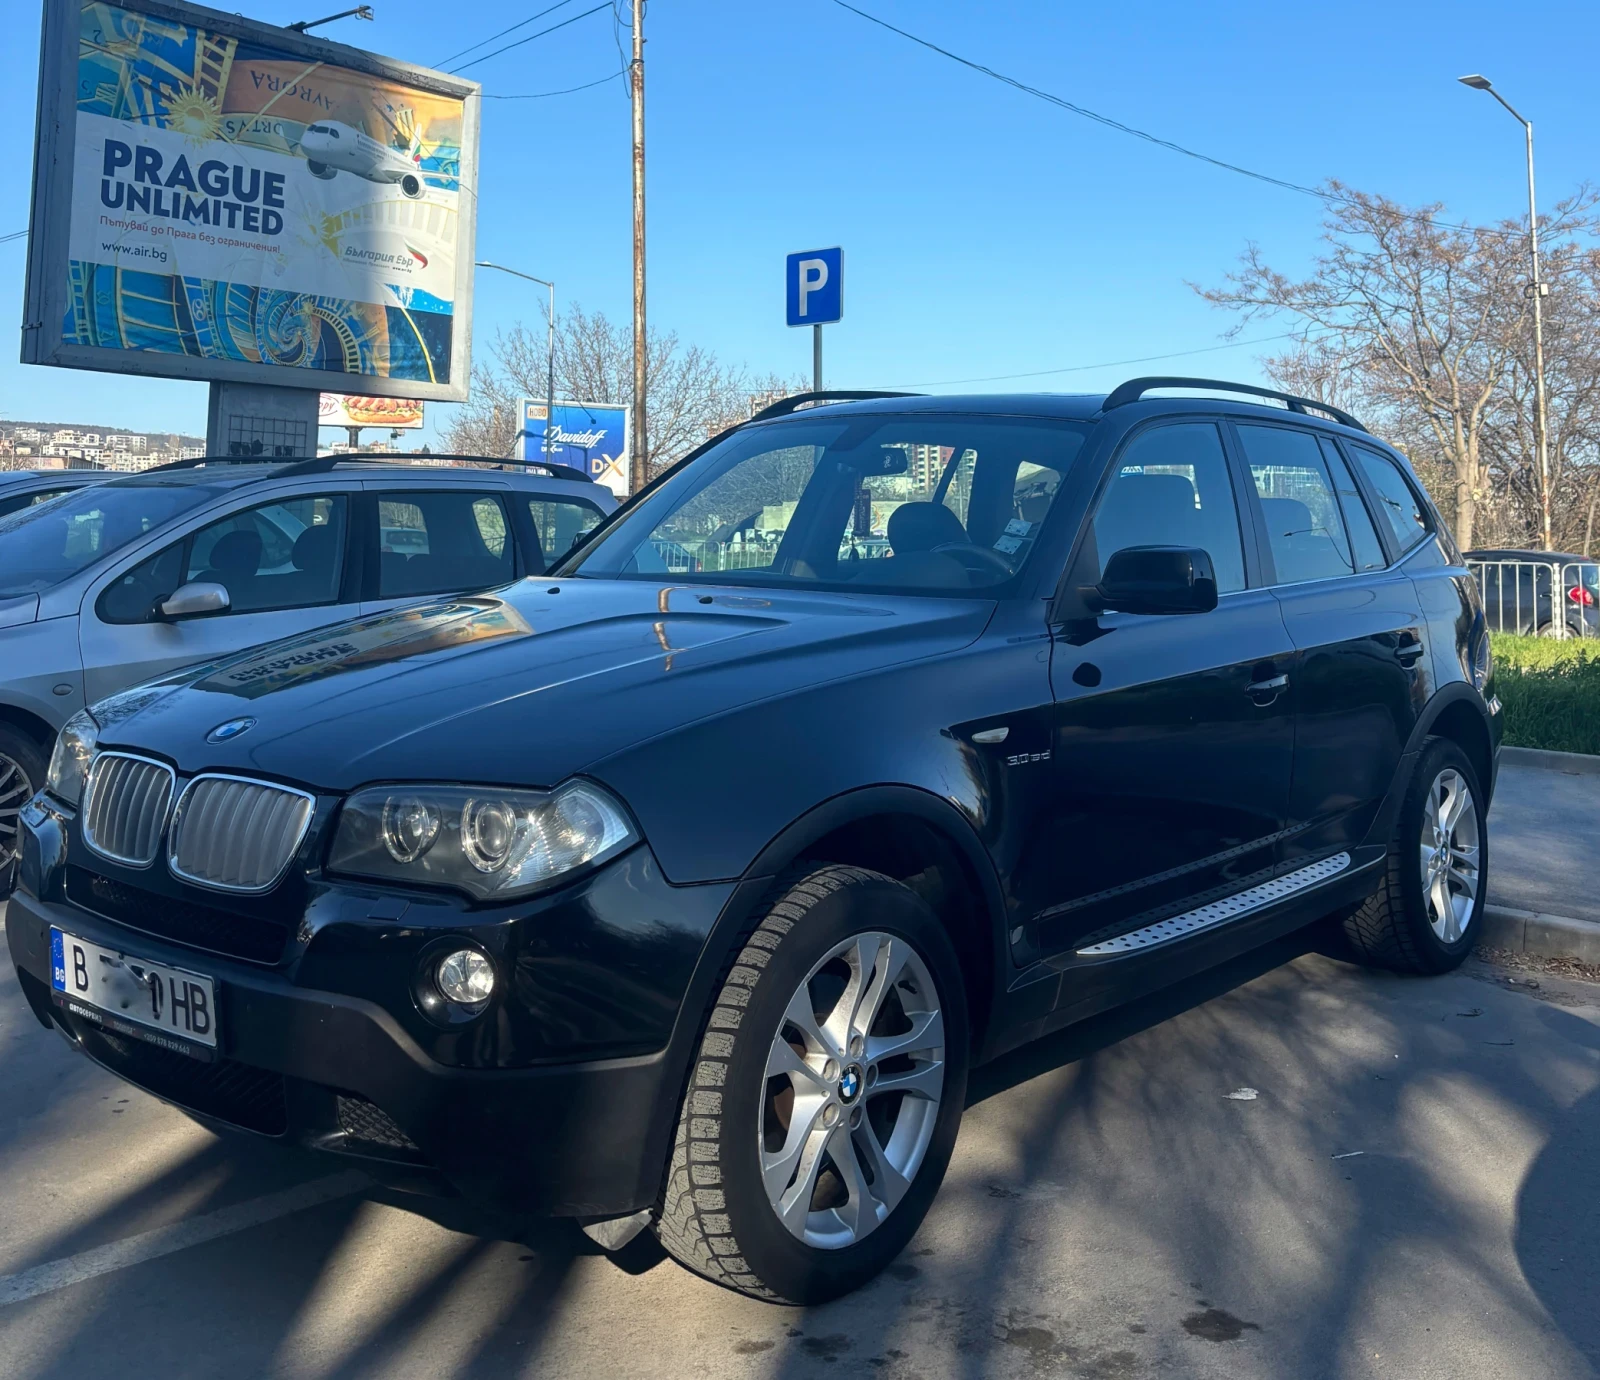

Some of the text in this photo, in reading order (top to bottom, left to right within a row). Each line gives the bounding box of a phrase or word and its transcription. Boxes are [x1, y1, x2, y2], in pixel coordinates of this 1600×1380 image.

[103, 138, 285, 209] PRAGUE
[100, 178, 284, 236] UNLIMITED
[100, 215, 281, 254] Пътувай до Прага без ограничения!
[102, 242, 168, 263] www.air.bg
[344, 246, 395, 263] България
[799, 258, 829, 317] P
[543, 425, 608, 449] Davidoff
[55, 966, 65, 983] BG
[169, 975, 211, 1035] HB
